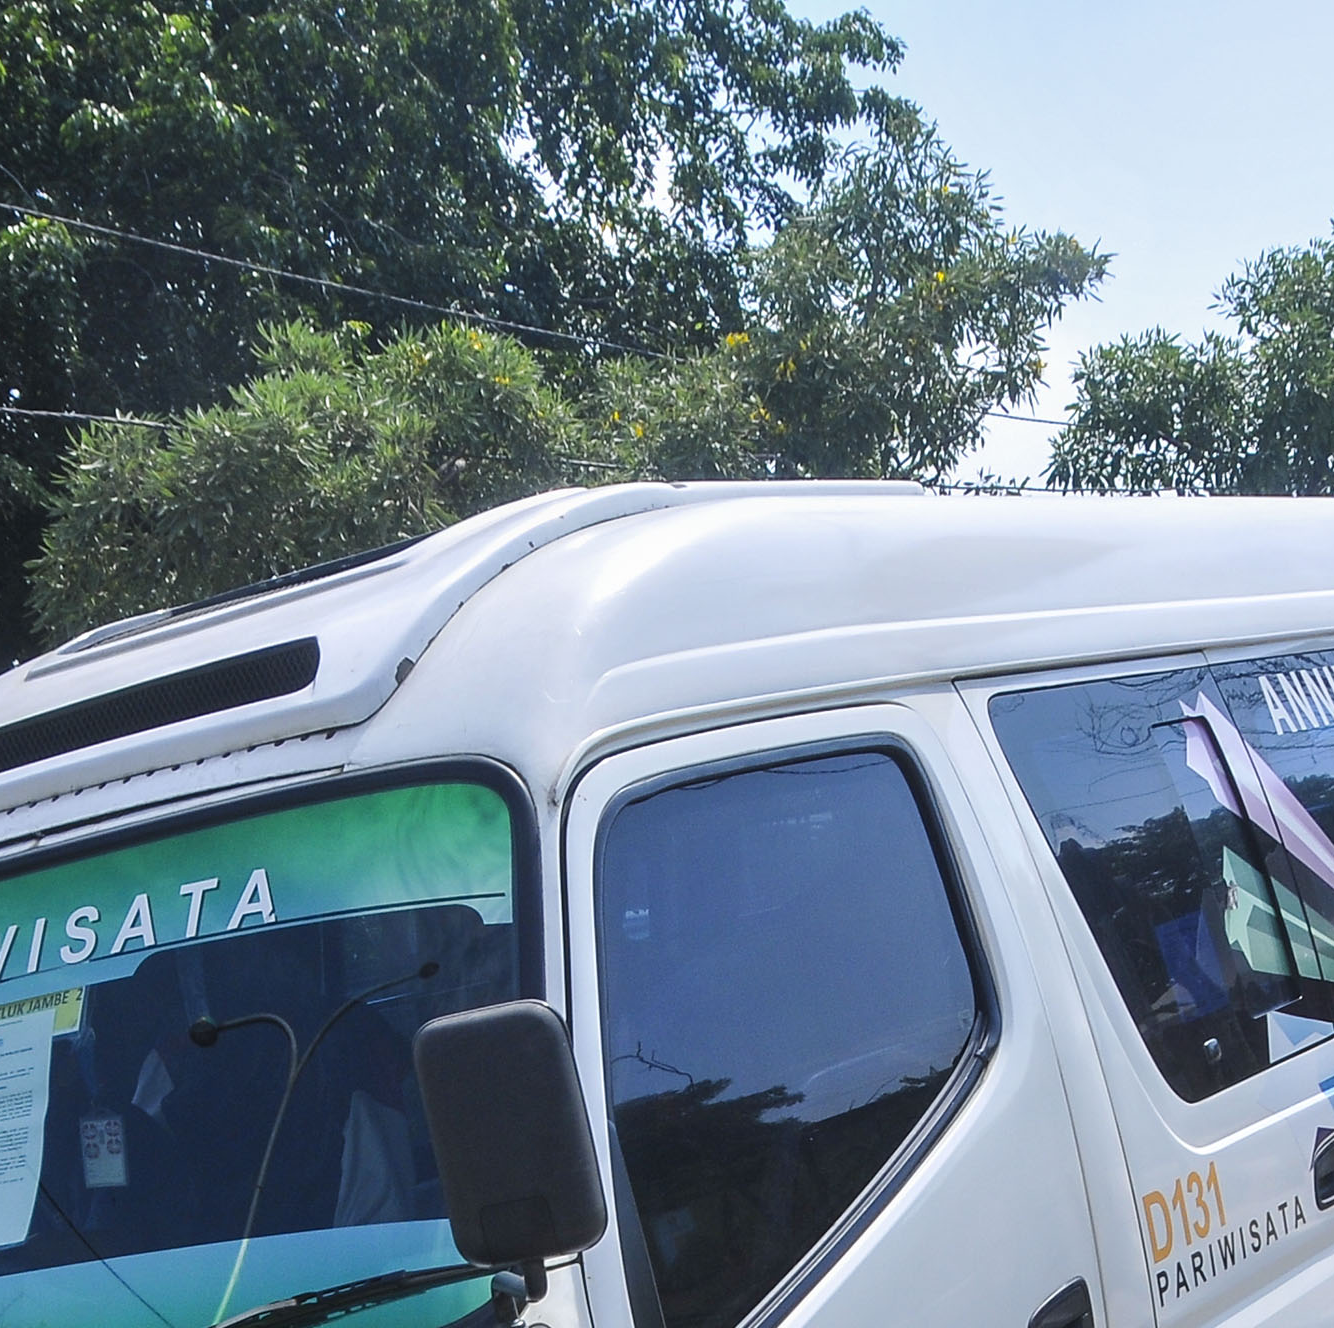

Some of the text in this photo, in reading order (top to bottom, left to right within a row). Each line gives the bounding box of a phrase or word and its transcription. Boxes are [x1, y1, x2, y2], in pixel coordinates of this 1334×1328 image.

[26, 991, 69, 1013] JAMBE
[1142, 1161, 1226, 1264] D131
[1156, 1196, 1306, 1307] PARIWISATA
